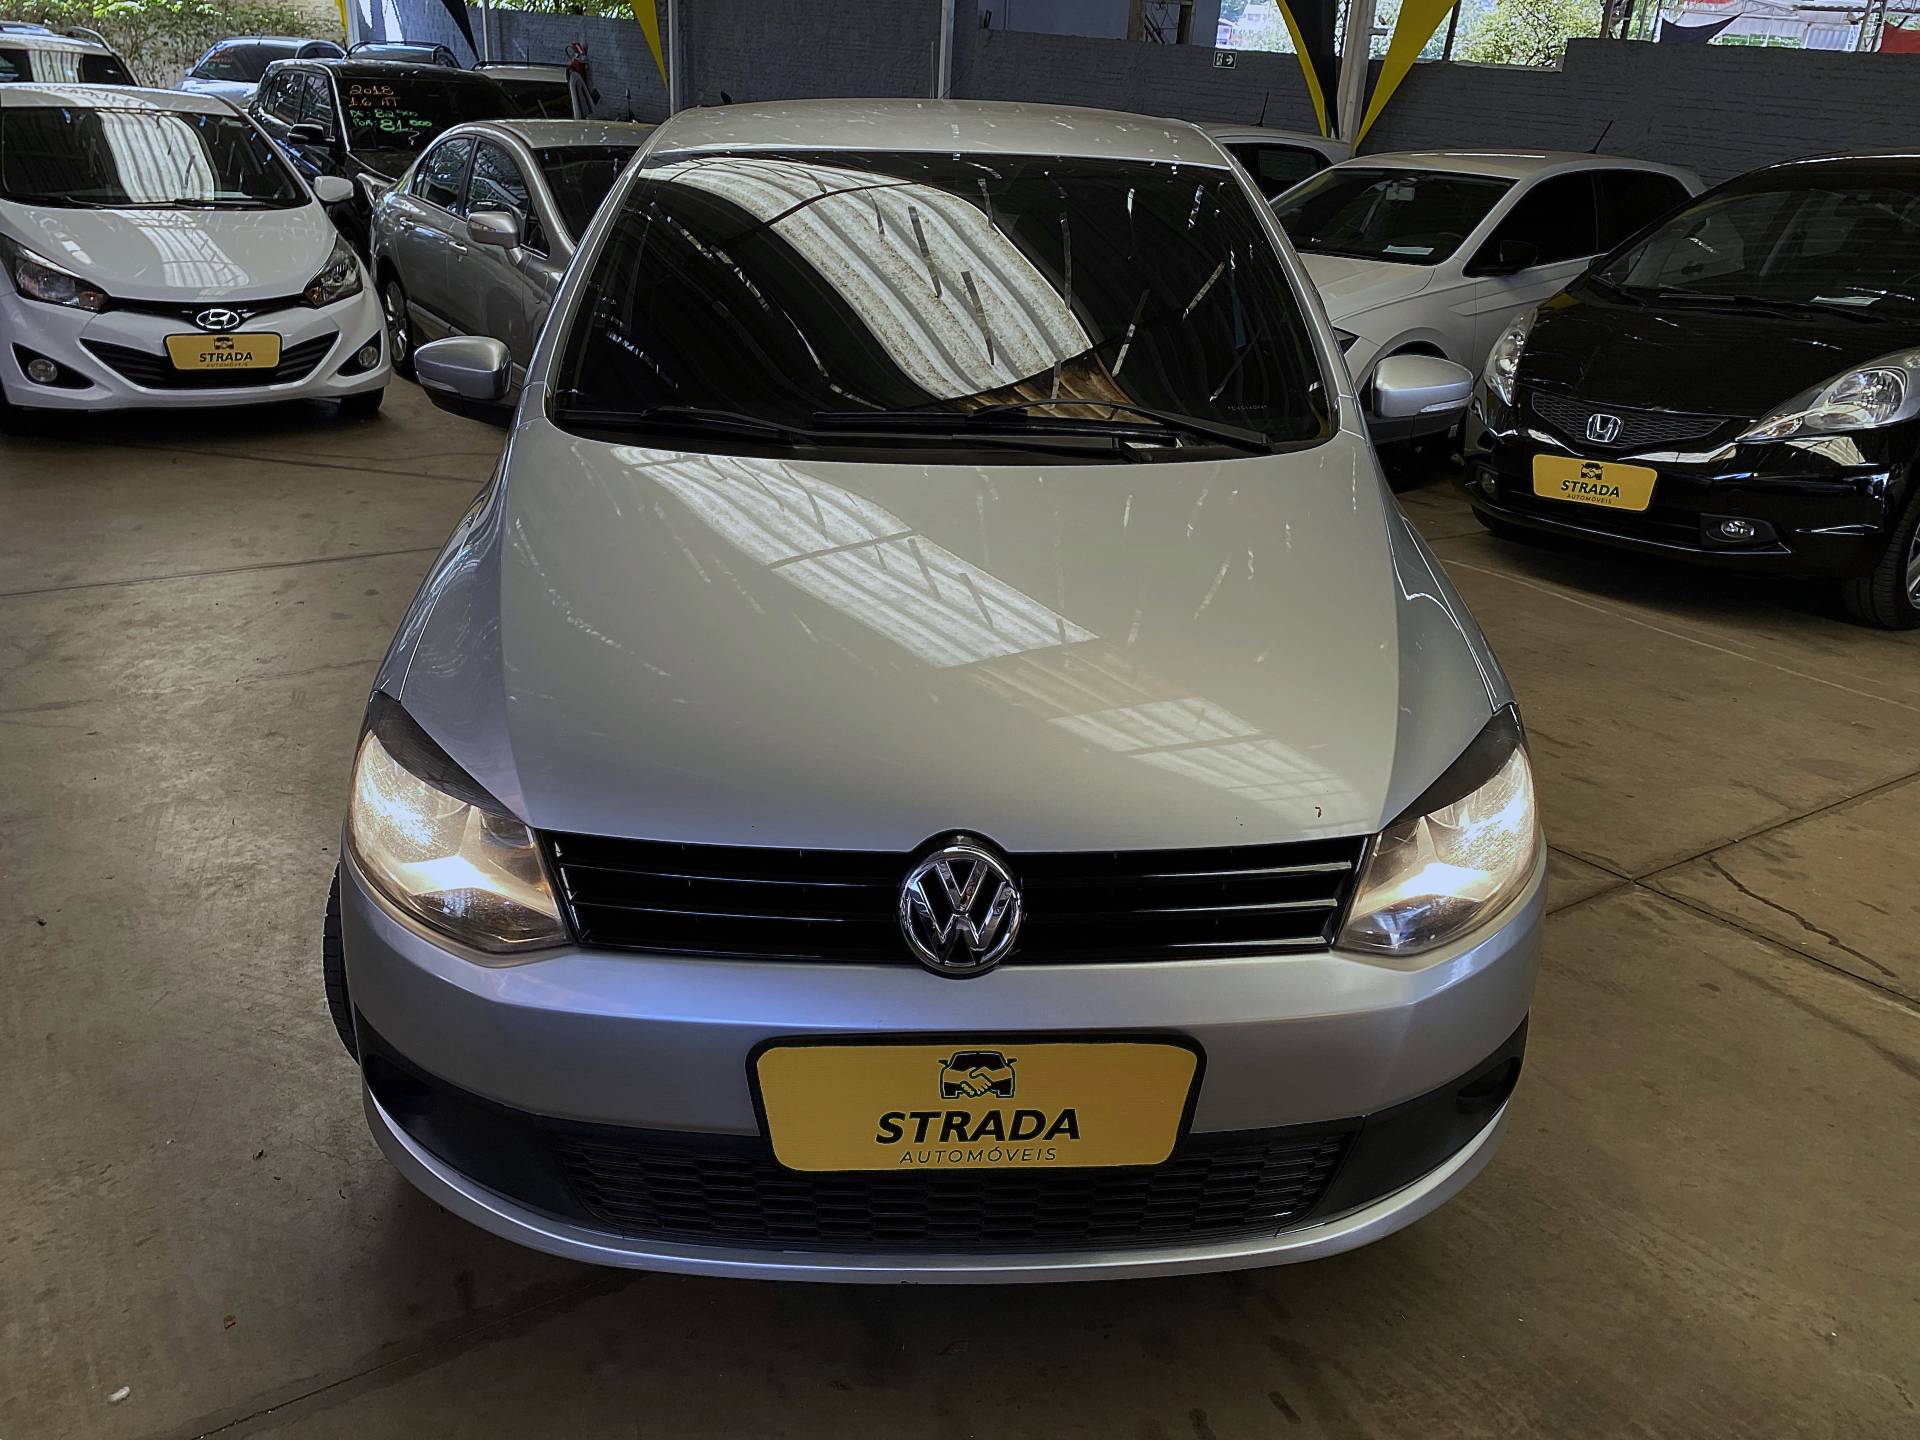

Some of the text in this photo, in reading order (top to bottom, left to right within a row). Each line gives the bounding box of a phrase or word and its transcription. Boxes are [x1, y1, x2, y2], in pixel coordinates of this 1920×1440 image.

[349, 84, 394, 96] 2018
[199, 352, 253, 362] STRADA
[1560, 480, 1620, 498] STRADA
[905, 856, 1015, 966] VW
[875, 1108, 1081, 1144] STRADA
[900, 1146, 1057, 1164] AUTOMÓVEIS
